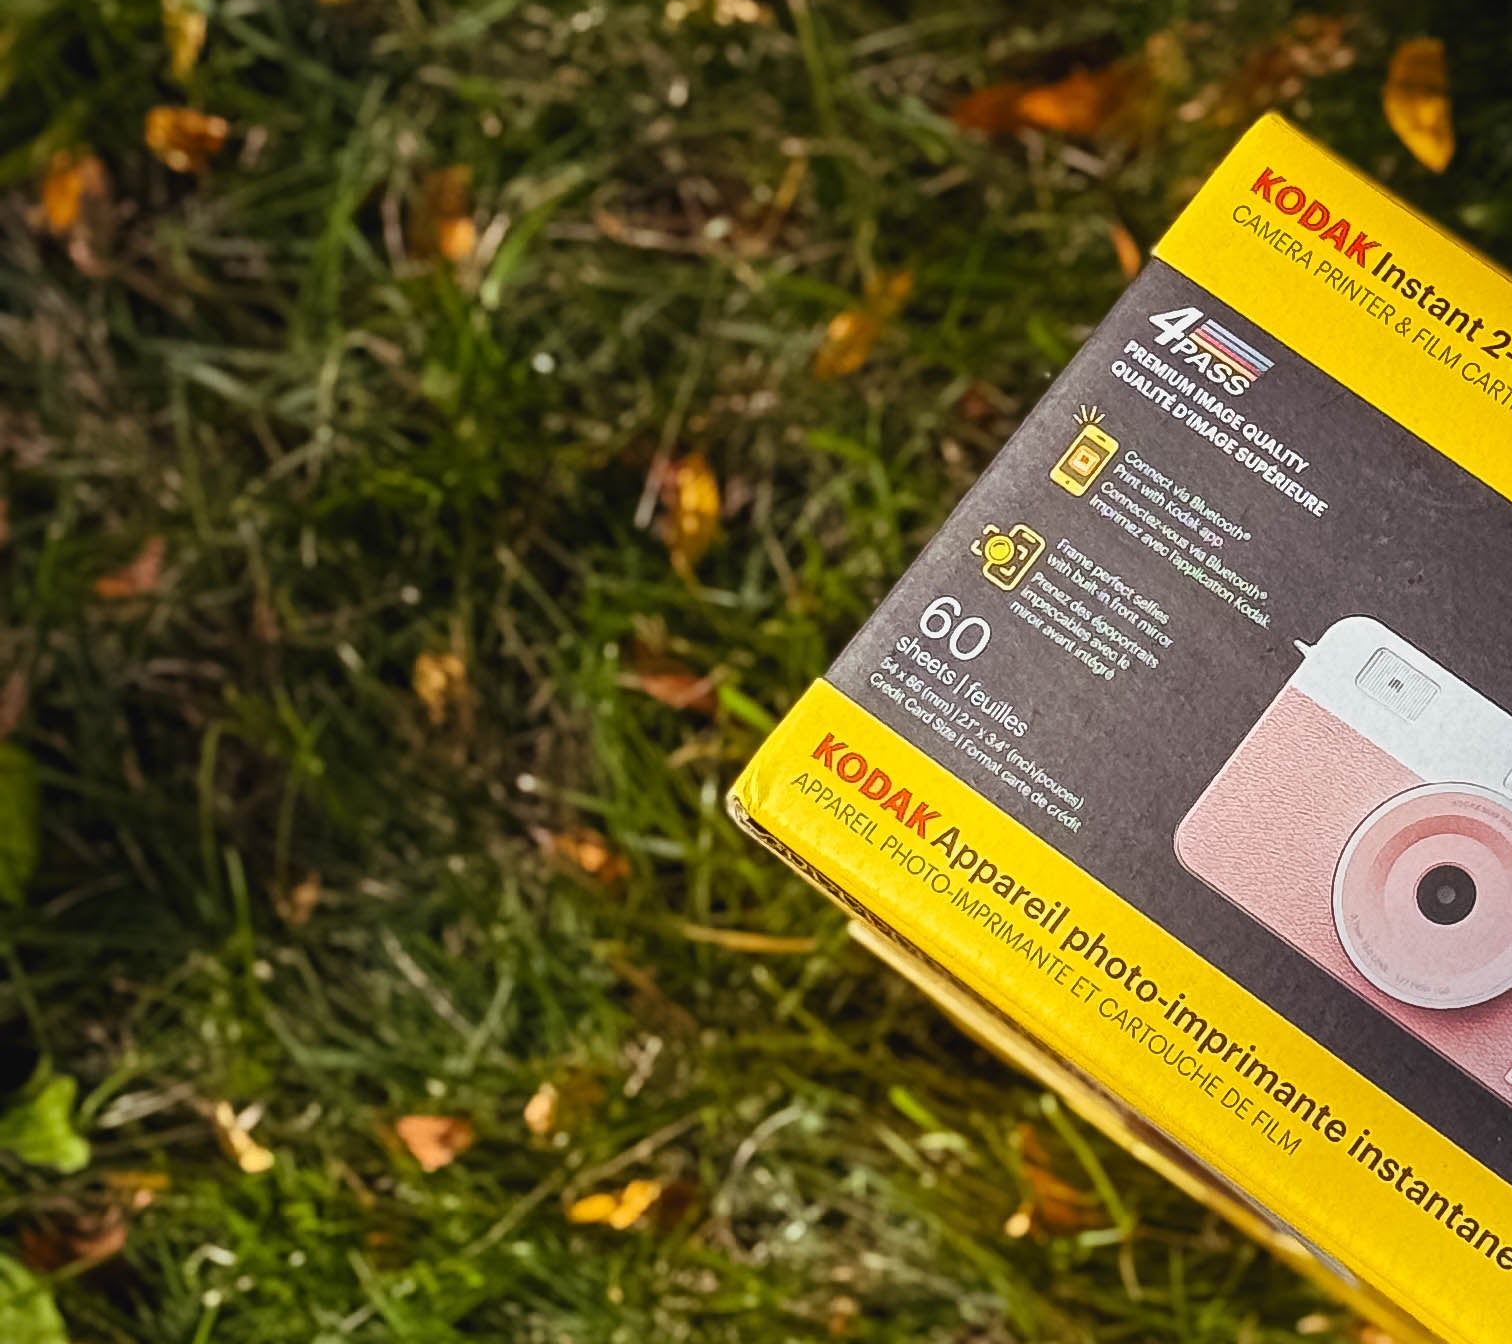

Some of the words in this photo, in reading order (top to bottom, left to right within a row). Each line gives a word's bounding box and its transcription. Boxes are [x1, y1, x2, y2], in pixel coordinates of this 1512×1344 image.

[1232, 204, 1312, 267] CAMERA
[1313, 259, 1395, 325] PRINTER
[1393, 316, 1411, 337] &
[1411, 327, 1462, 369] FILM
[1251, 168, 1379, 266] KODAK
[1371, 252, 1483, 341] Instant
[1111, 360, 1176, 411] QUALITÉ
[1172, 402, 1238, 454] D'IMAGE
[1234, 447, 1327, 516] SUPÉRIEURE
[1123, 340, 1195, 396] PREMIUM
[1192, 387, 1245, 430] IMAGE
[1242, 423, 1309, 473] QUALITY
[1100, 481, 1189, 549] Connectez-vous
[1188, 543, 1206, 562] via
[1112, 463, 1141, 489] Print
[1140, 483, 1165, 506] with
[1164, 500, 1201, 531] Kodak
[1124, 450, 1173, 490] Connect
[1172, 484, 1190, 502] via
[1056, 538, 1093, 570] Frame
[1089, 565, 1135, 600] perfect
[1132, 594, 1169, 624] selfies
[1089, 494, 1143, 537] Imprimez
[1140, 533, 1169, 556] avec
[1168, 549, 1234, 603] l'application
[919, 596, 990, 660] 60
[1009, 600, 1044, 628] miroir
[1041, 624, 1076, 652] avant
[1073, 646, 1115, 680] intégré
[1030, 571, 1071, 606] Prenez
[1069, 600, 1092, 620] des
[1090, 615, 1158, 668] égoportraits
[1047, 553, 1072, 577] with
[1070, 568, 1110, 604] built-in
[1108, 596, 1139, 624] front
[1136, 619, 1173, 648] mirror
[895, 636, 956, 684] sheets
[963, 681, 1027, 736] feuilles
[1089, 637, 1118, 661] avec
[1116, 653, 1130, 670] le
[869, 672, 905, 704] Credit
[904, 697, 936, 724] Card
[931, 717, 956, 741] Size
[960, 738, 1002, 775] Format
[1000, 770, 1031, 796] carte
[1030, 792, 1048, 808] de
[1046, 804, 1081, 833] crédit
[879, 656, 902, 678] 54
[920, 686, 955, 716] (mm)
[1006, 748, 1084, 810] (inch/pouces)
[790, 772, 877, 844] APPAREIL
[880, 835, 1073, 984] PHOTO-IMPRIMANTE
[1069, 975, 1101, 1003] ET
[1098, 997, 1223, 1097] CARTOUCHE
[1219, 1087, 1254, 1120] DE
[1250, 1109, 1302, 1155] FILM
[812, 733, 939, 837] KODAK
[930, 826, 1069, 933] Appareil
[1060, 927, 1346, 1141] photo-imprimante
